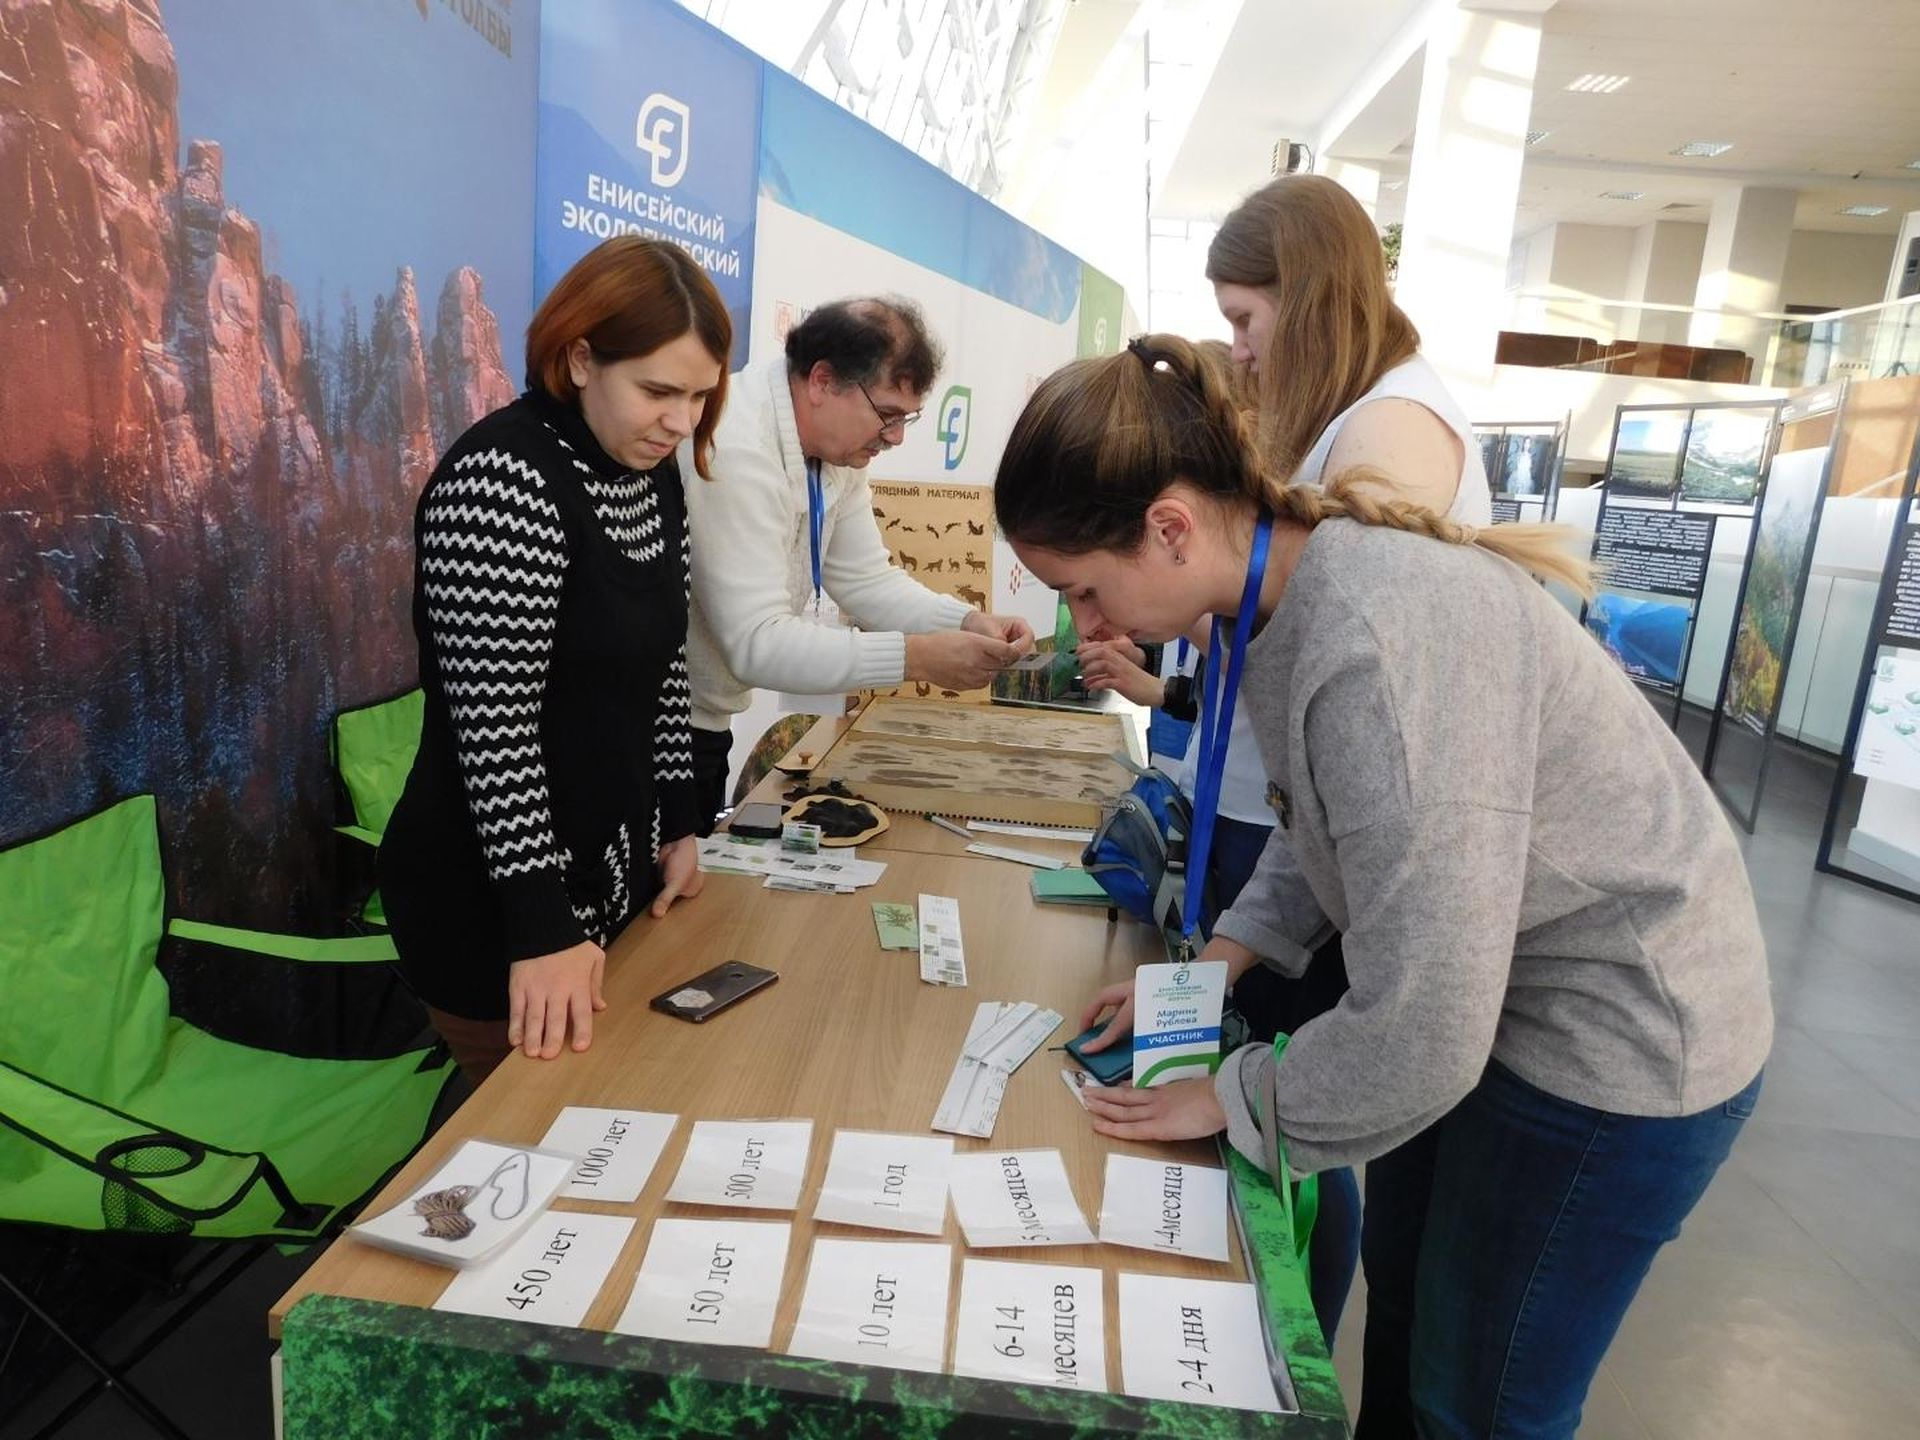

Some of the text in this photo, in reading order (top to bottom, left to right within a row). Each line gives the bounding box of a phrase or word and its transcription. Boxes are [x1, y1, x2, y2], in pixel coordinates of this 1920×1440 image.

[440, 0, 512, 59] ОЛБЫ
[587, 173, 725, 244] ЕНИСЕЙСКИЙ
[927, 489, 980, 500] МАТЕРИАЛ
[1148, 1031, 1205, 1045] УЧАСТНИК
[571, 1117, 631, 1187] 1000 лет
[743, 1138, 765, 1170] лет
[883, 1164, 908, 1196] год
[506, 1228, 577, 1311] 450 лет
[686, 1242, 736, 1325] 150 лет
[858, 1274, 897, 1348] 10 лет
[992, 1305, 1025, 1358] 6-14
[1053, 1283, 1079, 1386] месяцев
[1176, 1306, 1214, 1394] 2-4 дня
